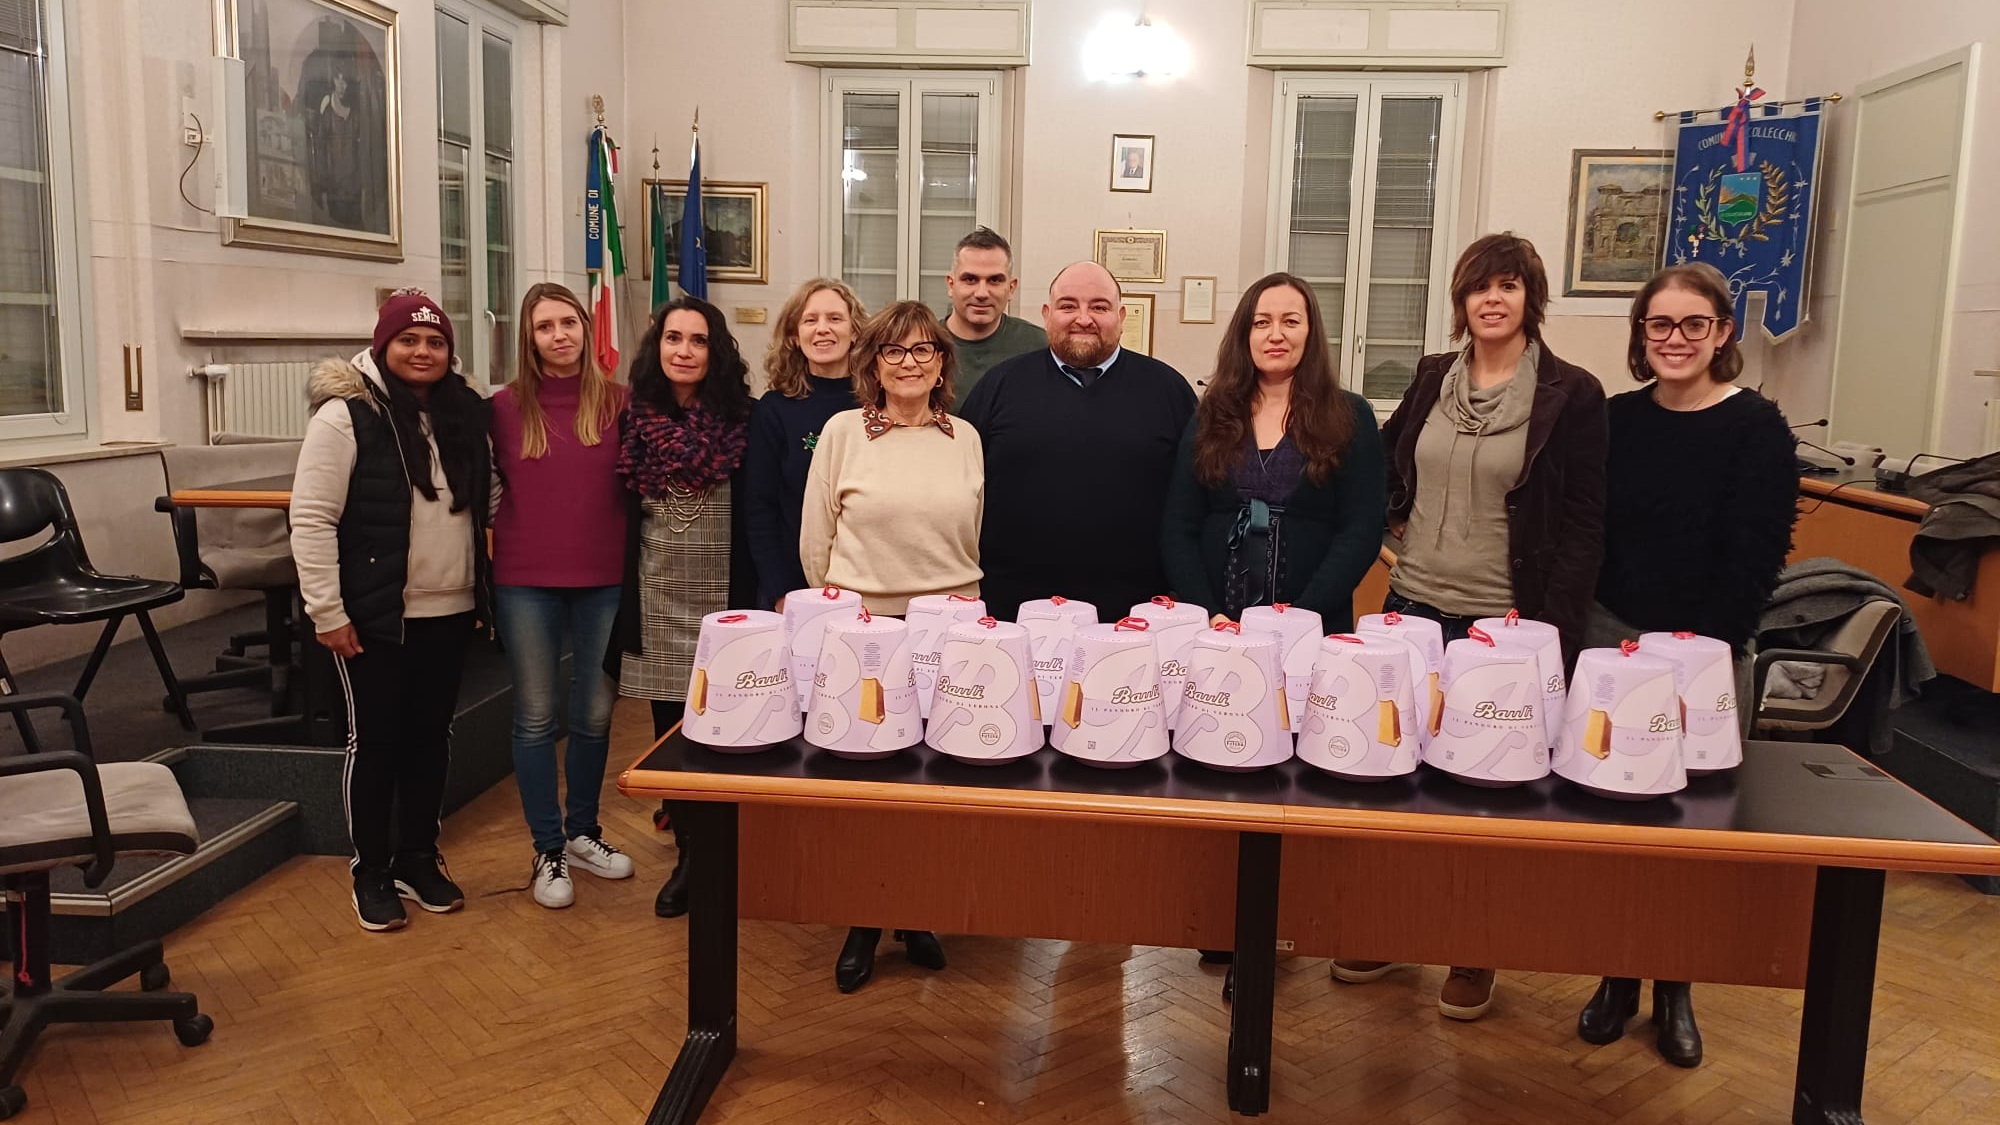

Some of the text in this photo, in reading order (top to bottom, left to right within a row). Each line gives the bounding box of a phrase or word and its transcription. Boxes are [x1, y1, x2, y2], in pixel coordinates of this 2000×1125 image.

[1698, 132, 1726, 151] COMUN
[588, 189, 600, 240] COMUNE DI
[1033, 657, 1064, 672] auli
[735, 667, 789, 690] Bauli
[938, 675, 985, 700] Bauli
[1184, 681, 1231, 708] Bauli
[1308, 692, 1337, 711] auli
[1473, 700, 1534, 721] Bauli
